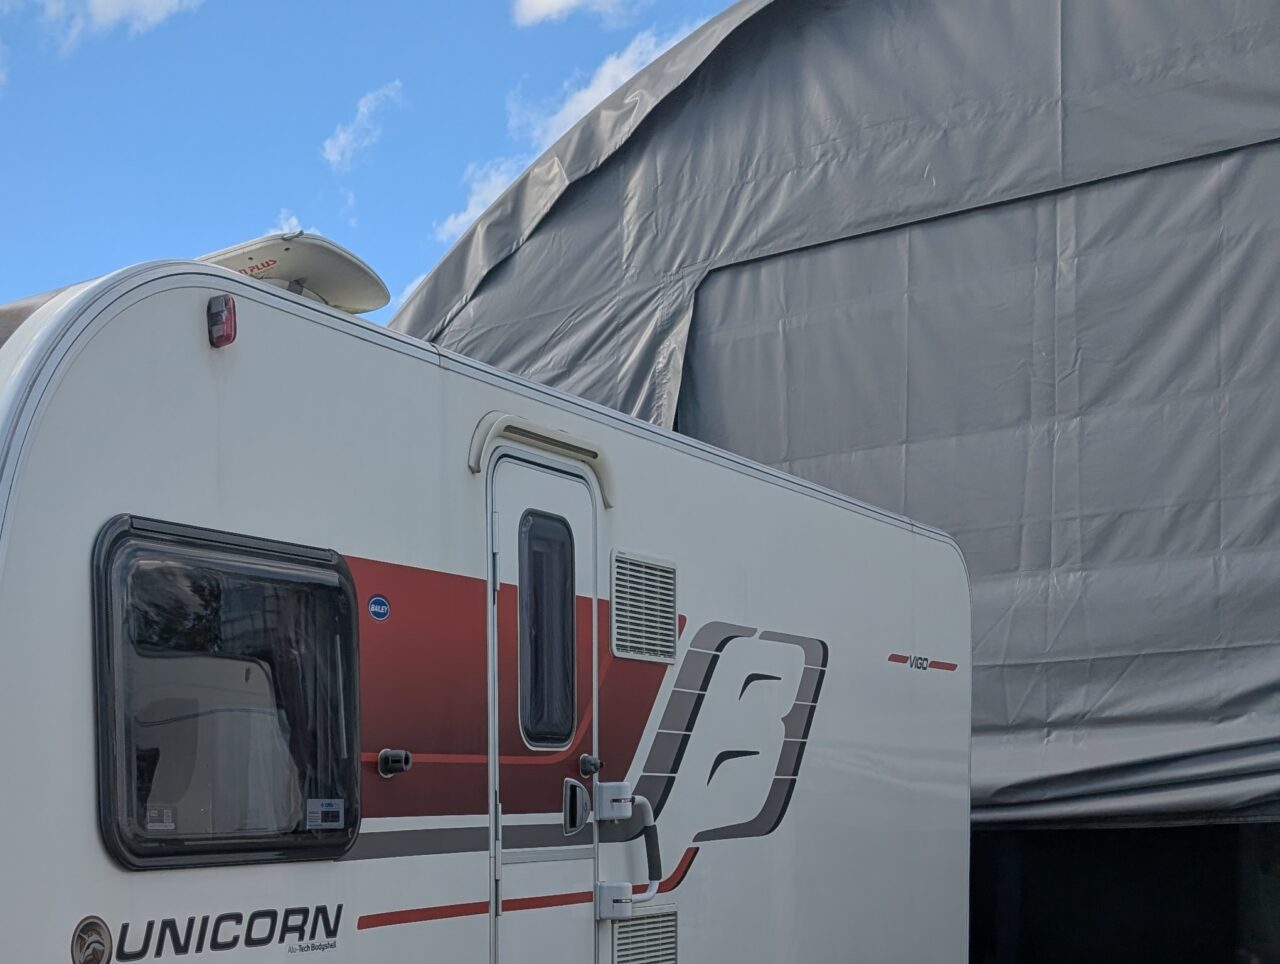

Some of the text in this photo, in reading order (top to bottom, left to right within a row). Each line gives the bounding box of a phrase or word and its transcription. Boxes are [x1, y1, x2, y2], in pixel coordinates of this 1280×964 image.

[248, 259, 277, 272] PLUS
[909, 655, 928, 670] VIGO
[115, 903, 344, 963] UNICORN
